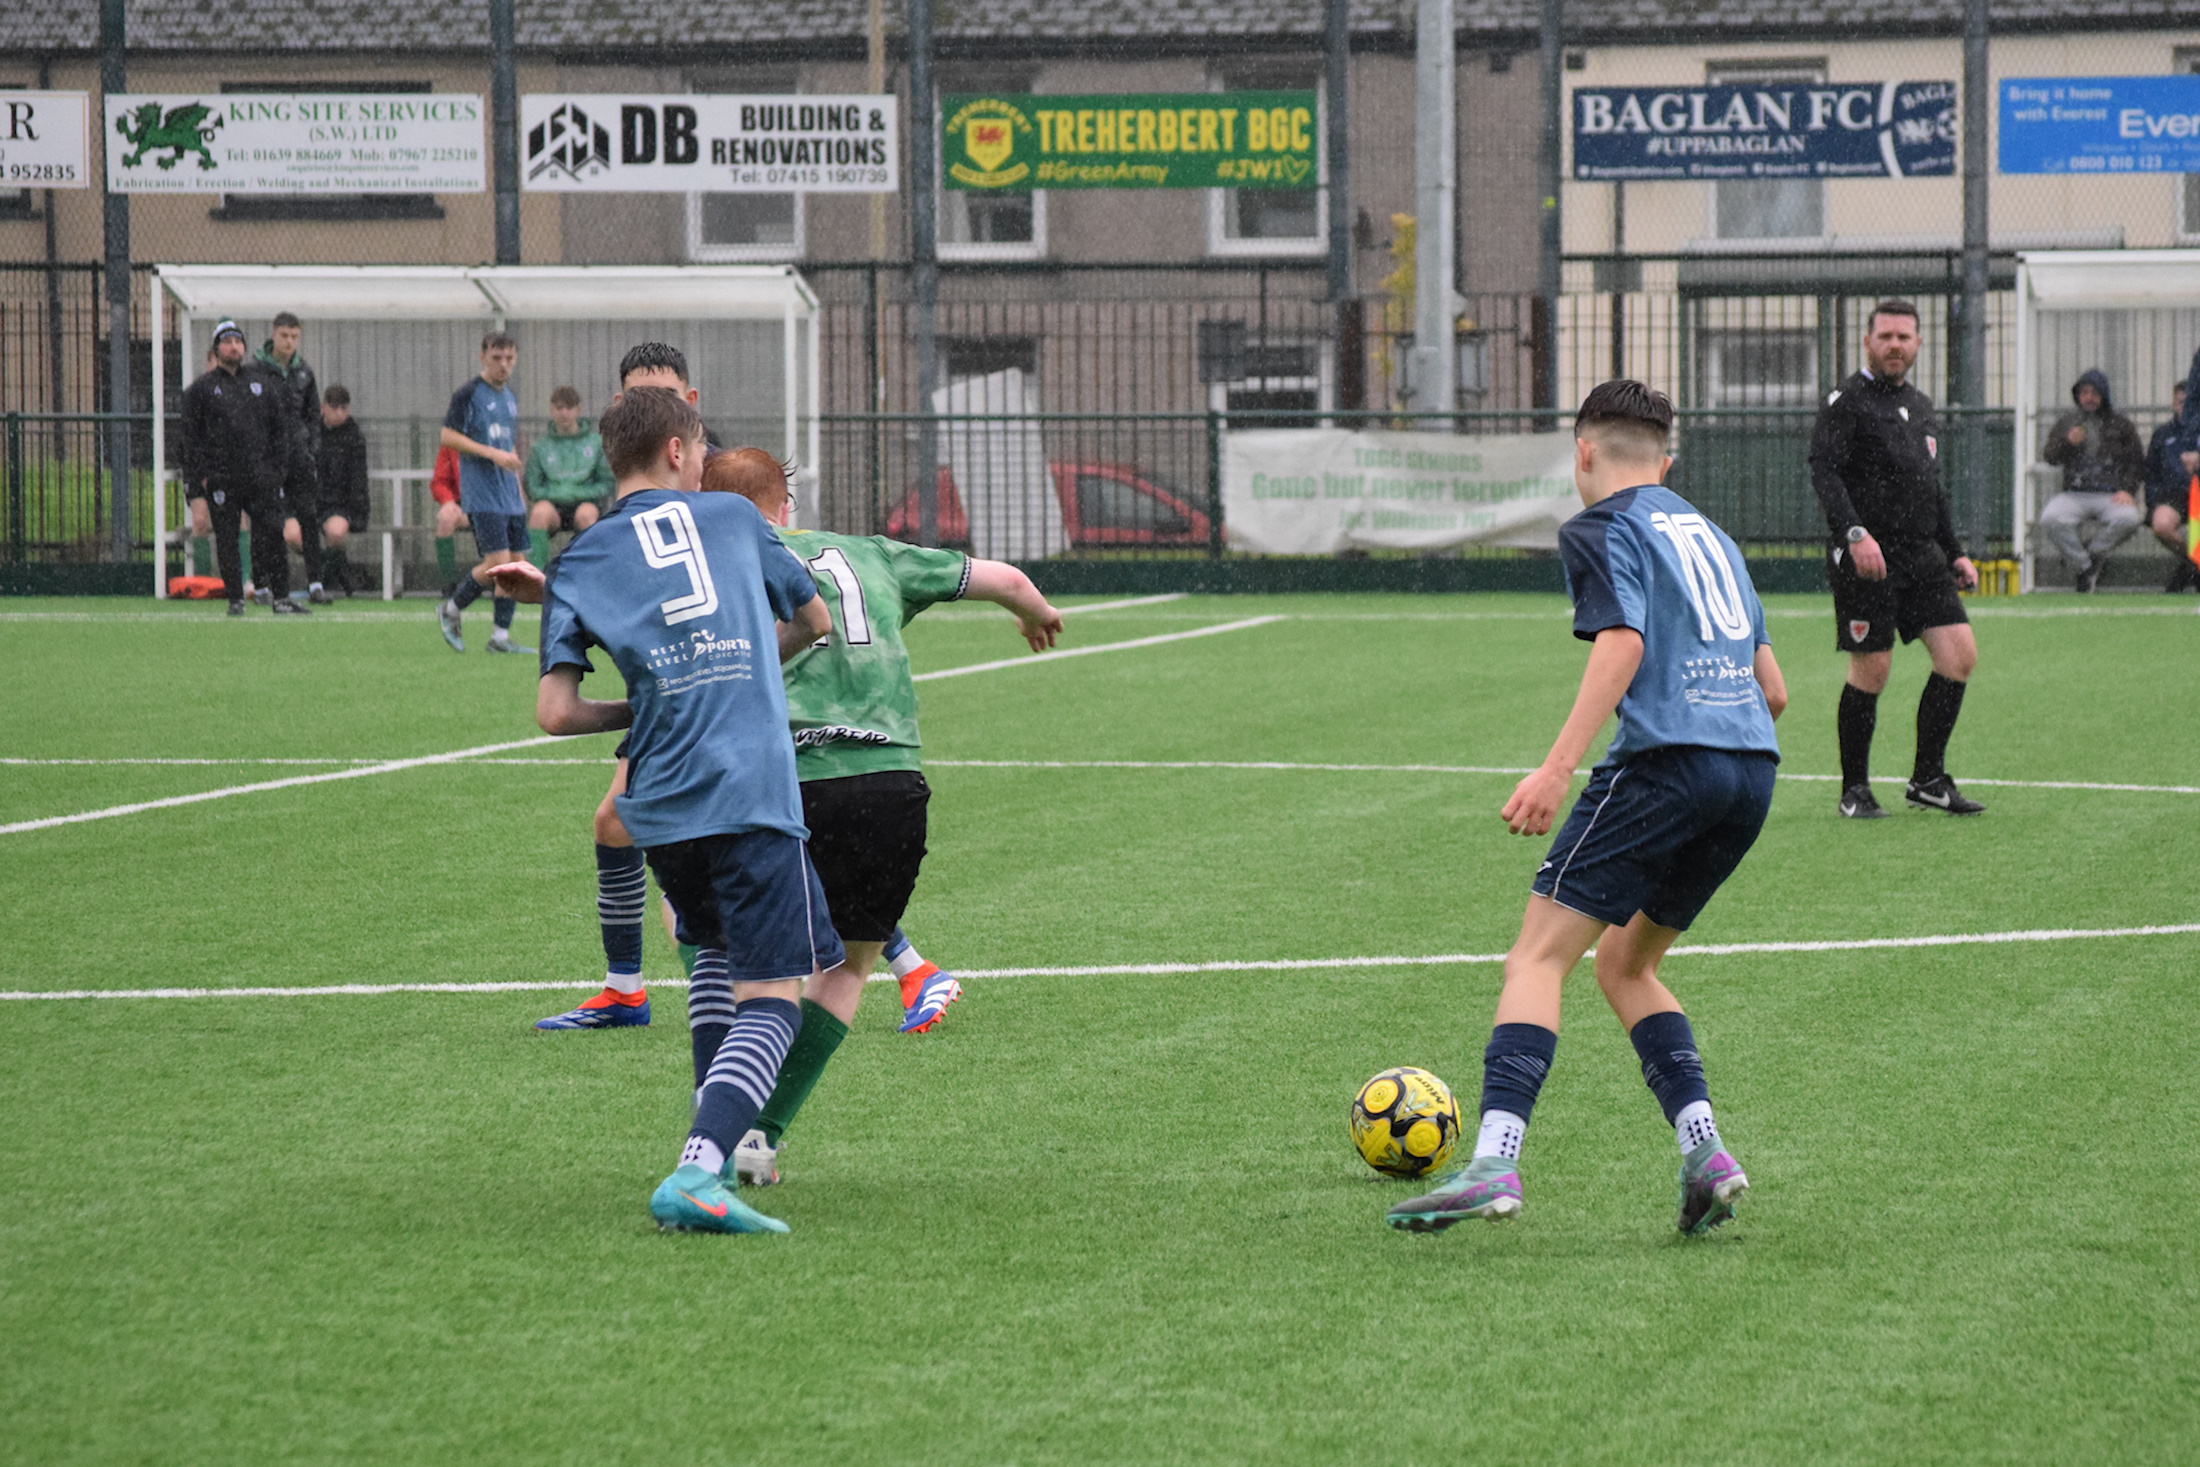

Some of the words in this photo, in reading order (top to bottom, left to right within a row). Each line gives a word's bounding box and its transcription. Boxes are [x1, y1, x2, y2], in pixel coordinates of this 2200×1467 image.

[2008, 86, 2050, 104] Bring
[2054, 87, 2064, 99] it
[2068, 86, 2112, 100] home
[0, 101, 40, 141] R
[229, 101, 291, 121] KING
[298, 101, 351, 121] SITE
[358, 101, 477, 121] SERVICES
[741, 104, 860, 132] BUILDING
[868, 108, 886, 132] &
[1580, 92, 1794, 134] BAGLAN
[1808, 90, 1873, 131] FC
[2013, 106, 2047, 121] with
[2051, 106, 2108, 121] Everest
[309, 125, 357, 142] (S.W.)
[362, 125, 397, 141] LTD
[621, 103, 700, 165] DB
[1036, 108, 1239, 153] TREHERBERT
[1248, 107, 1311, 152] BGC
[226, 149, 249, 161] Tel:
[253, 149, 292, 161] 01639
[295, 149, 342, 161] 884669
[350, 149, 384, 161] Mob:
[389, 149, 427, 161] 07967
[711, 138, 886, 166] RENOVATIONS
[1646, 135, 1806, 156] #UPPABAGLAN
[10, 164, 75, 180] 952835
[731, 169, 762, 184] Tel:
[767, 169, 820, 184] 07415
[827, 169, 888, 184] 190739
[1037, 159, 1169, 184] #GreenArmy
[116, 177, 185, 189] Fabrication
[195, 177, 245, 189] Erection
[257, 177, 305, 190] Welding
[309, 177, 329, 188] and
[334, 177, 401, 188] Mechanical
[404, 177, 478, 188] Installations
[1251, 472, 1317, 499] Gone
[1323, 471, 1365, 499] but
[1371, 477, 1448, 500] never
[630, 501, 719, 626] 9
[1650, 511, 1751, 641] 10
[790, 546, 873, 647] 1
[650, 641, 685, 656] NEXT
[647, 653, 689, 670] LEVEL
[1686, 658, 1721, 668] NEXT
[1681, 669, 1716, 679] LEVE
